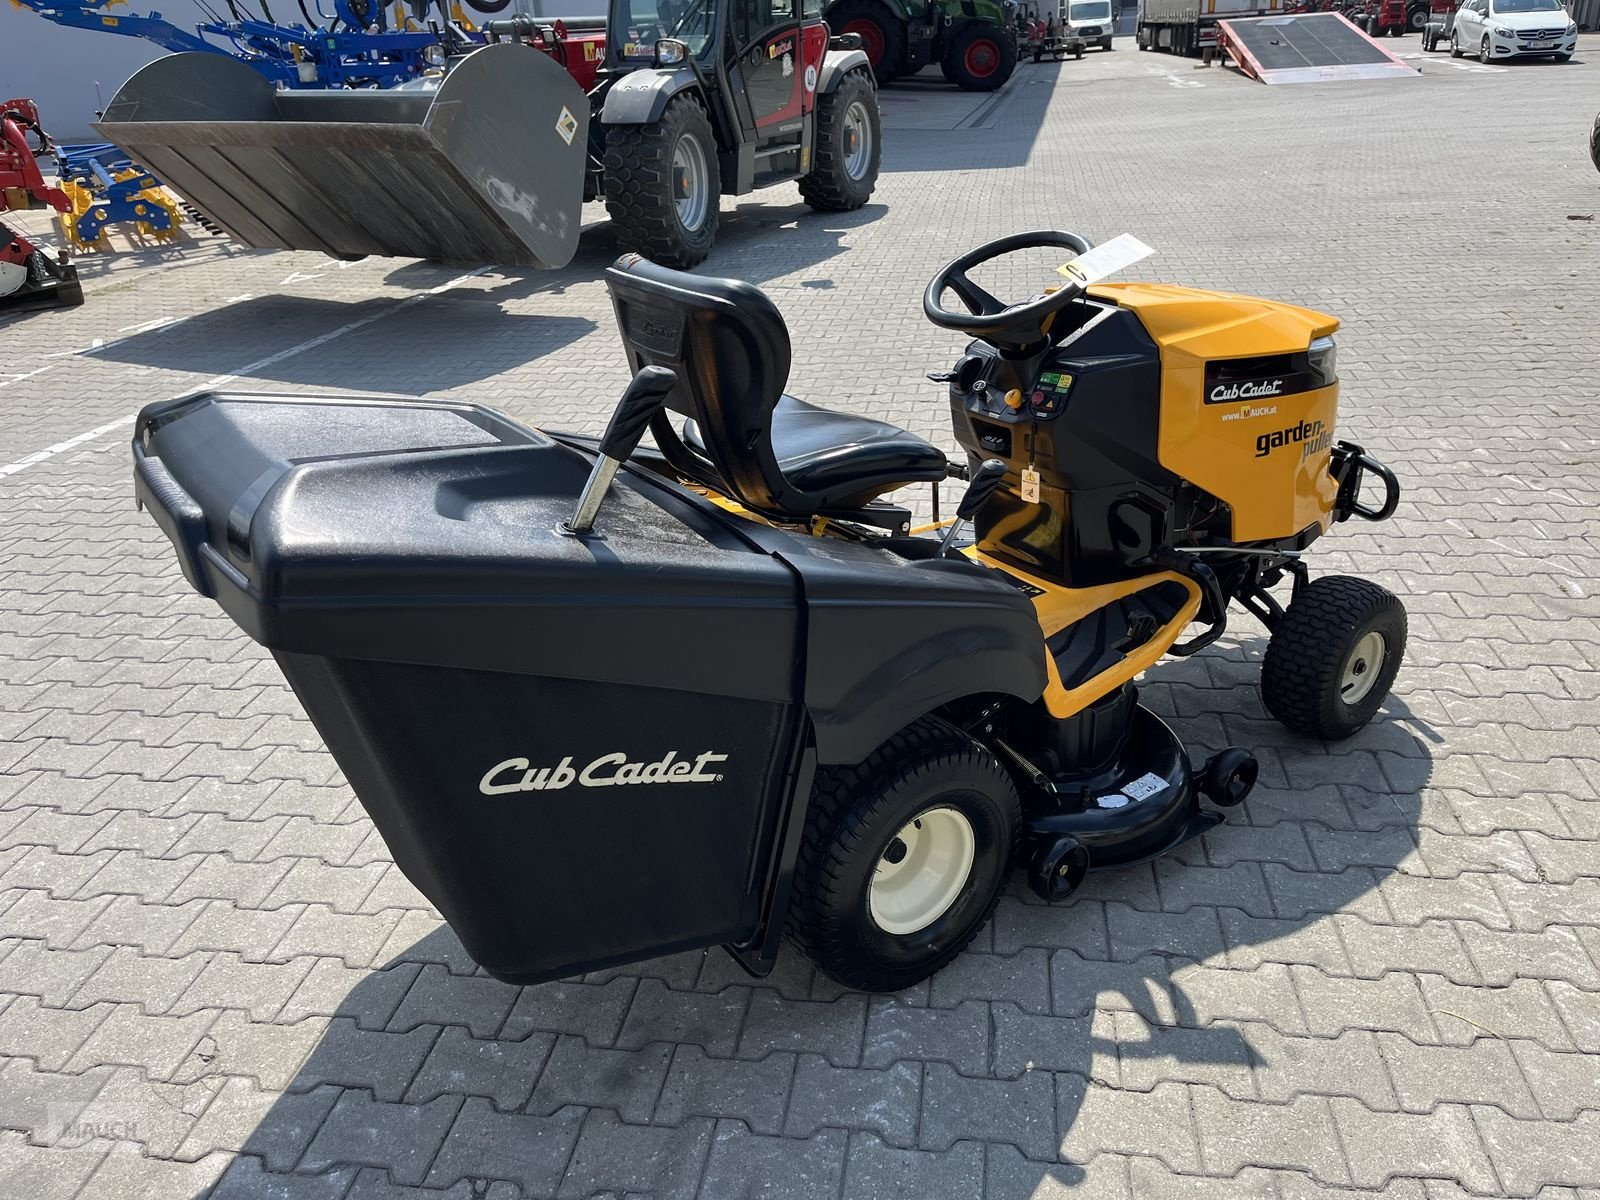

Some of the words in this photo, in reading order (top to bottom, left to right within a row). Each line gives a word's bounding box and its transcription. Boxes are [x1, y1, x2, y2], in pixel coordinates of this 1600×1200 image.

[1210, 384, 1239, 401] Cub
[1240, 380, 1282, 397] Cadet
[1221, 406, 1277, 421] www.MAUCH.at
[1255, 420, 1325, 457] garden-
[479, 756, 576, 795] Cub
